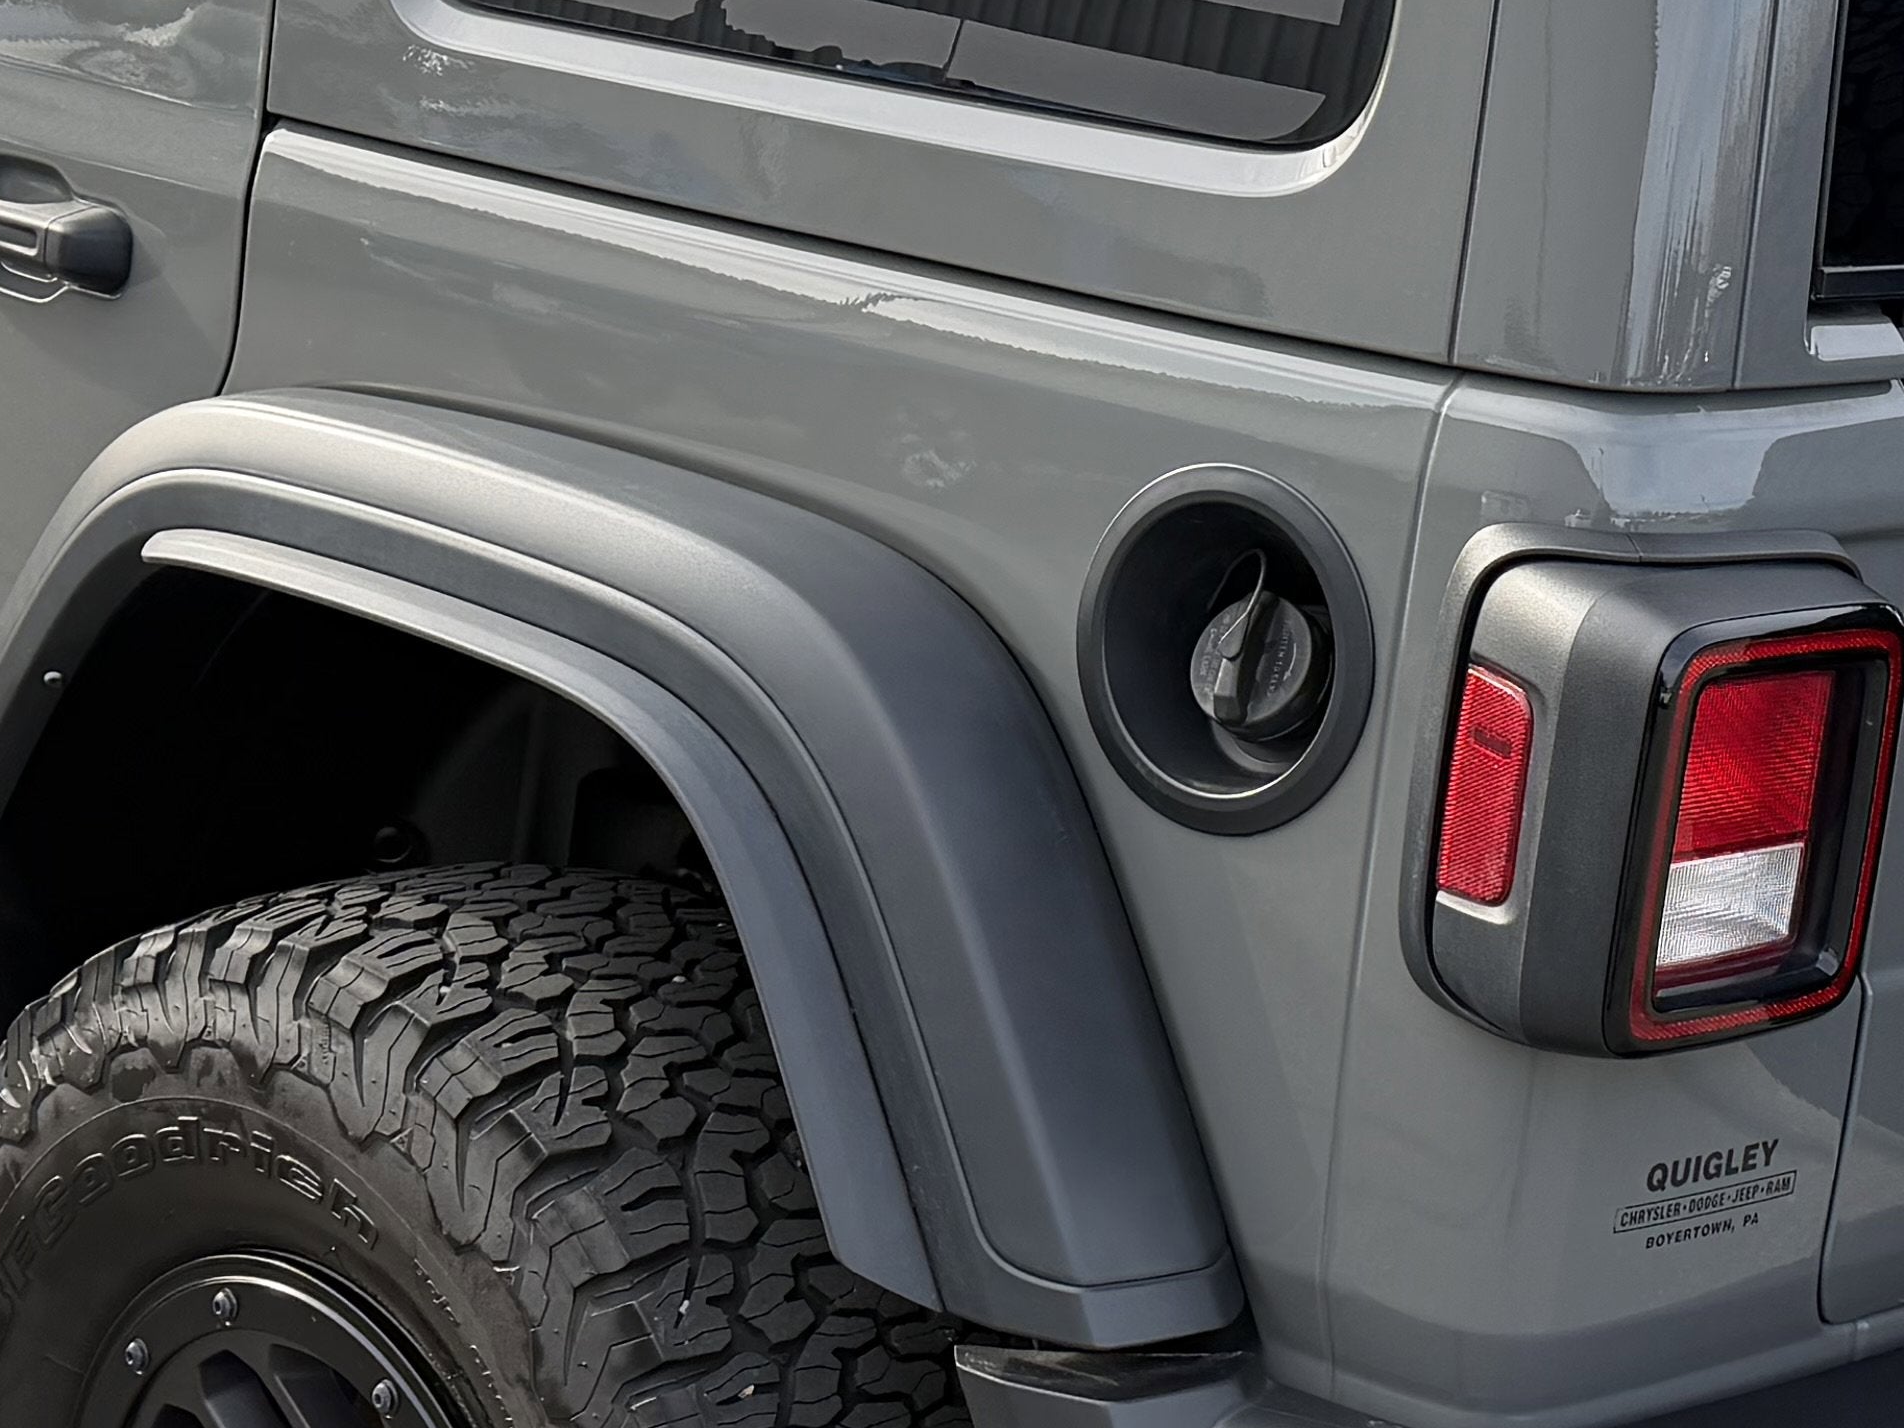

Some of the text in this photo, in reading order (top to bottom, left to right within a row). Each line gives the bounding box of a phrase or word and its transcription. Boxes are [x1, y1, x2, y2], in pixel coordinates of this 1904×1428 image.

[1645, 1138, 1779, 1193] QUIGLEY
[1619, 1175, 1792, 1228] CHRYSLER DODGE JEEP RAM
[1645, 1212, 1759, 1249] BOYERTOWN, PA
